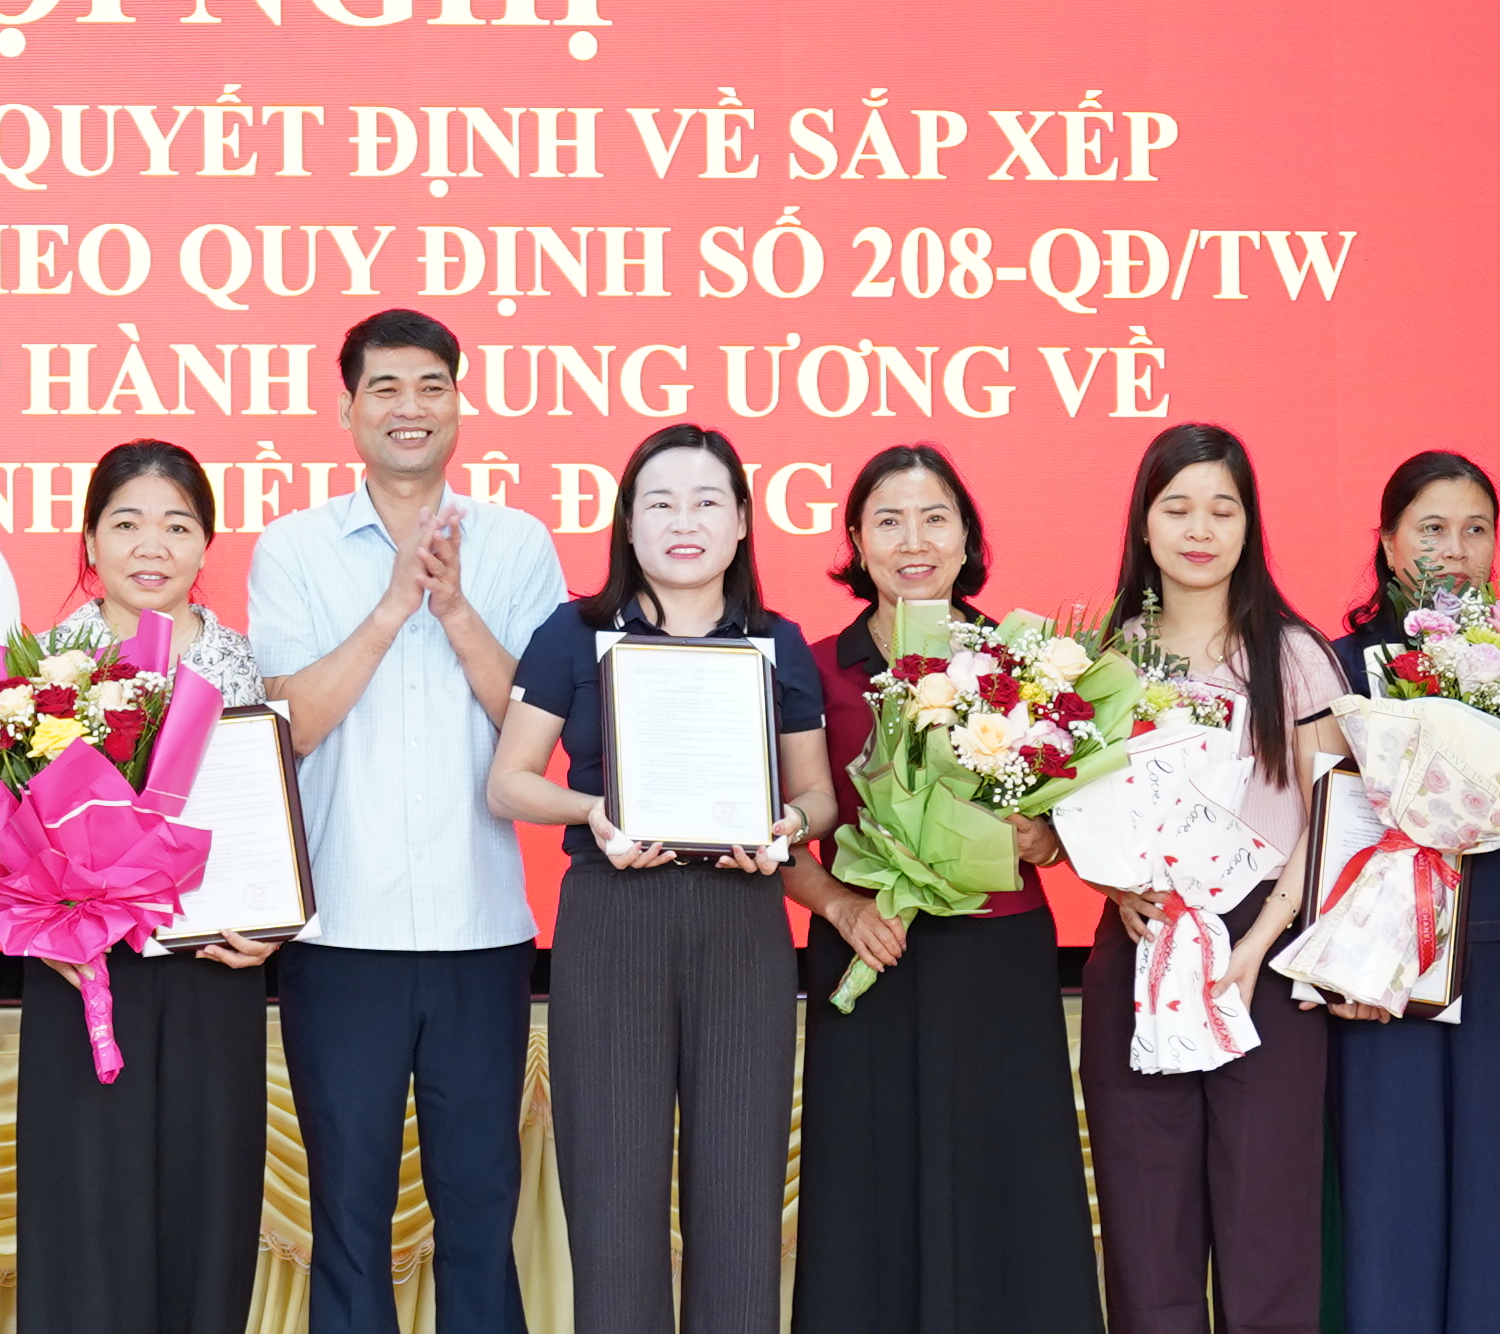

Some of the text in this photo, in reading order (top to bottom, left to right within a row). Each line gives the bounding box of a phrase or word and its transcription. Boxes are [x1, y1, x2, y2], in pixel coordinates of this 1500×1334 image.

[349, 106, 604, 199] ĐỊNH
[626, 86, 759, 180] VỀ
[790, 87, 967, 181] SẮP
[988, 88, 1178, 182] XẾP
[180, 223, 396, 311] QUY
[417, 225, 671, 317] ĐỊNH
[700, 205, 824, 299] SỐ
[852, 226, 1357, 314] 208-QĐ/TW
[22, 322, 317, 416] HÀNH
[457, 344, 694, 418] UNG
[719, 331, 1016, 419] ƯƠNG
[1038, 325, 1169, 419] VỀ
[552, 462, 838, 535] ĐG
[1420, 907, 1432, 945] CHANEL
